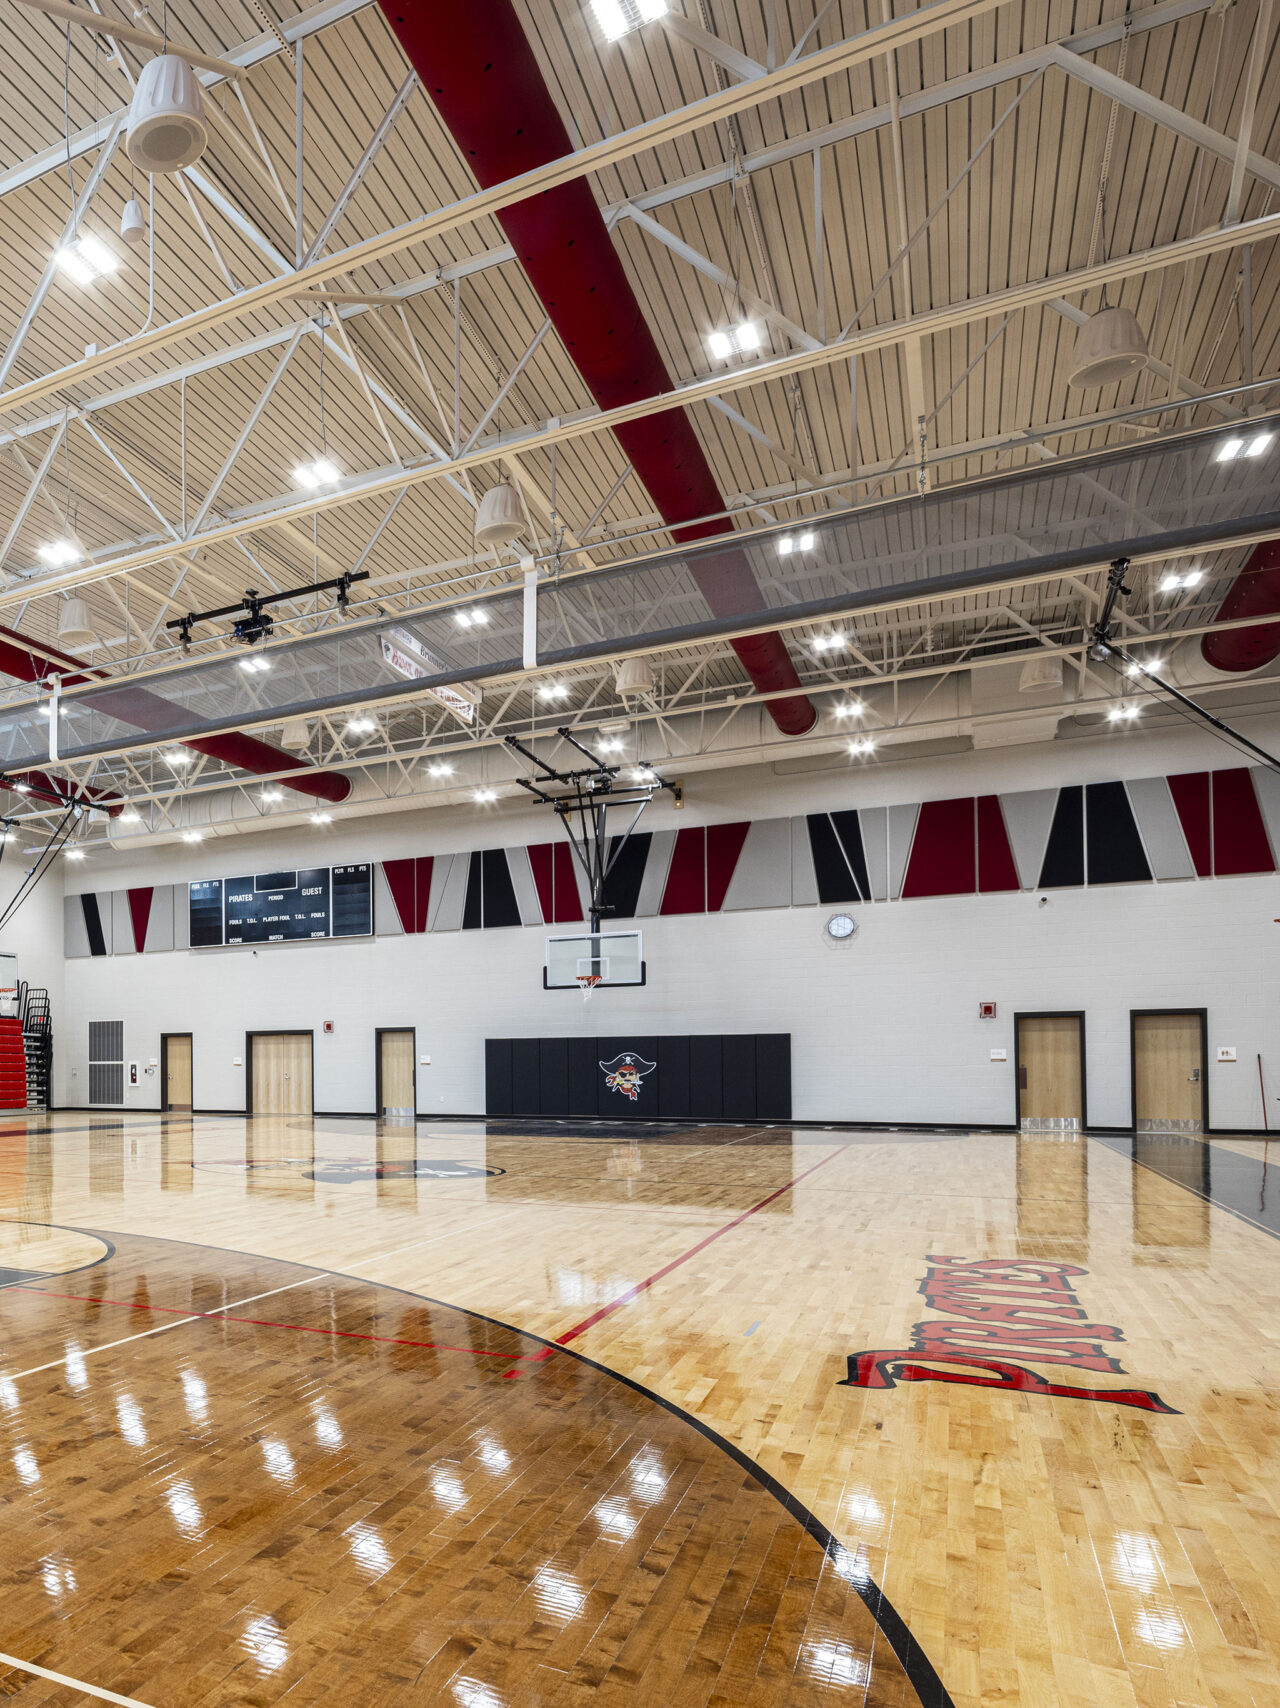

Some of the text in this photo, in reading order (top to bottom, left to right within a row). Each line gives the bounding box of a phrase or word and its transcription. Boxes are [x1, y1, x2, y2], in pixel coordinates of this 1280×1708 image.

[302, 887, 323, 896] GUEST
[229, 893, 253, 903] PIRATES
[311, 911, 325, 919] FOULS
[311, 930, 325, 938] SCORE
[836, 1254, 1185, 1415] PIRATES
